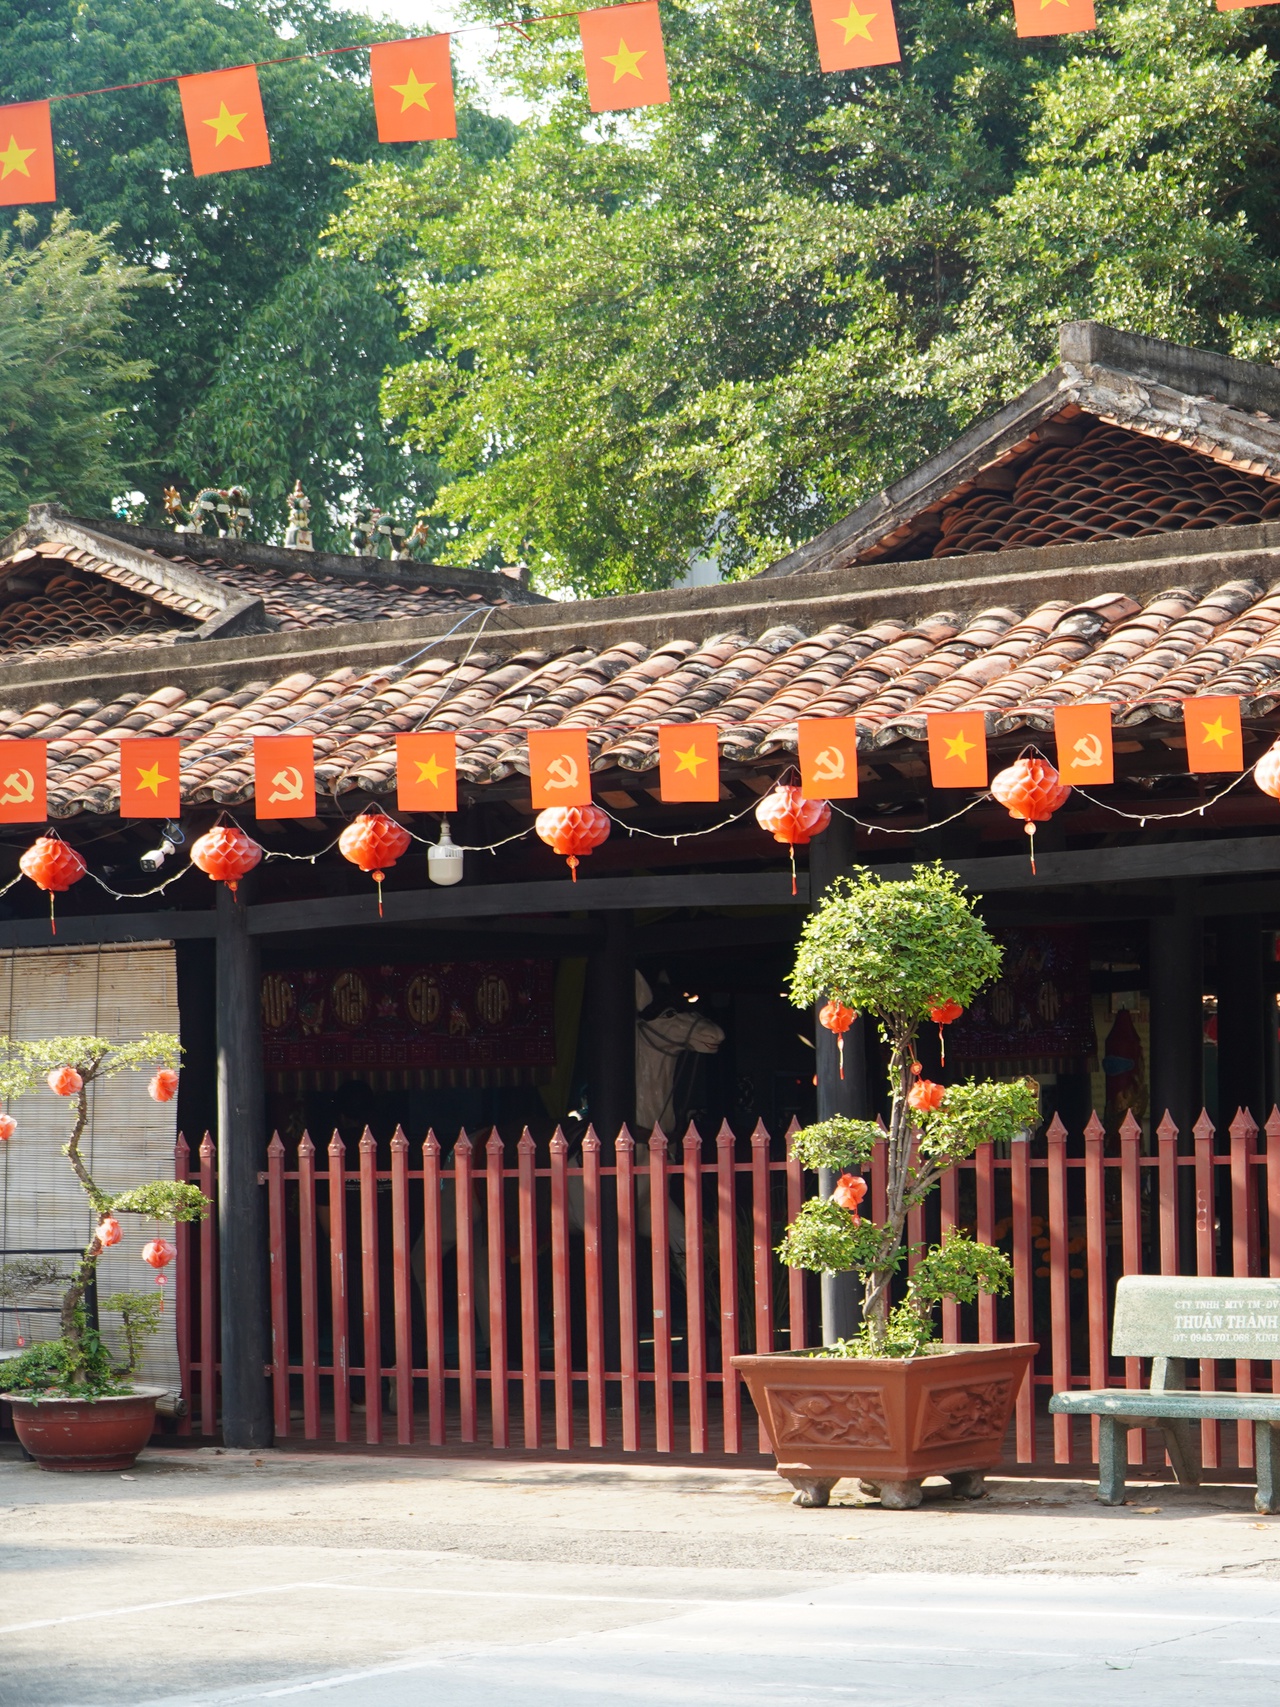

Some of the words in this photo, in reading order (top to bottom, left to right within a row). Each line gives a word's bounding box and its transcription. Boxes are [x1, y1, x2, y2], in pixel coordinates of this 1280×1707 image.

[408, 975, 440, 1025] GIÓ
[1174, 1300, 1193, 1309] CTY
[1173, 1311, 1223, 1332] THUẬN
[1226, 1312, 1279, 1329] THÀNH
